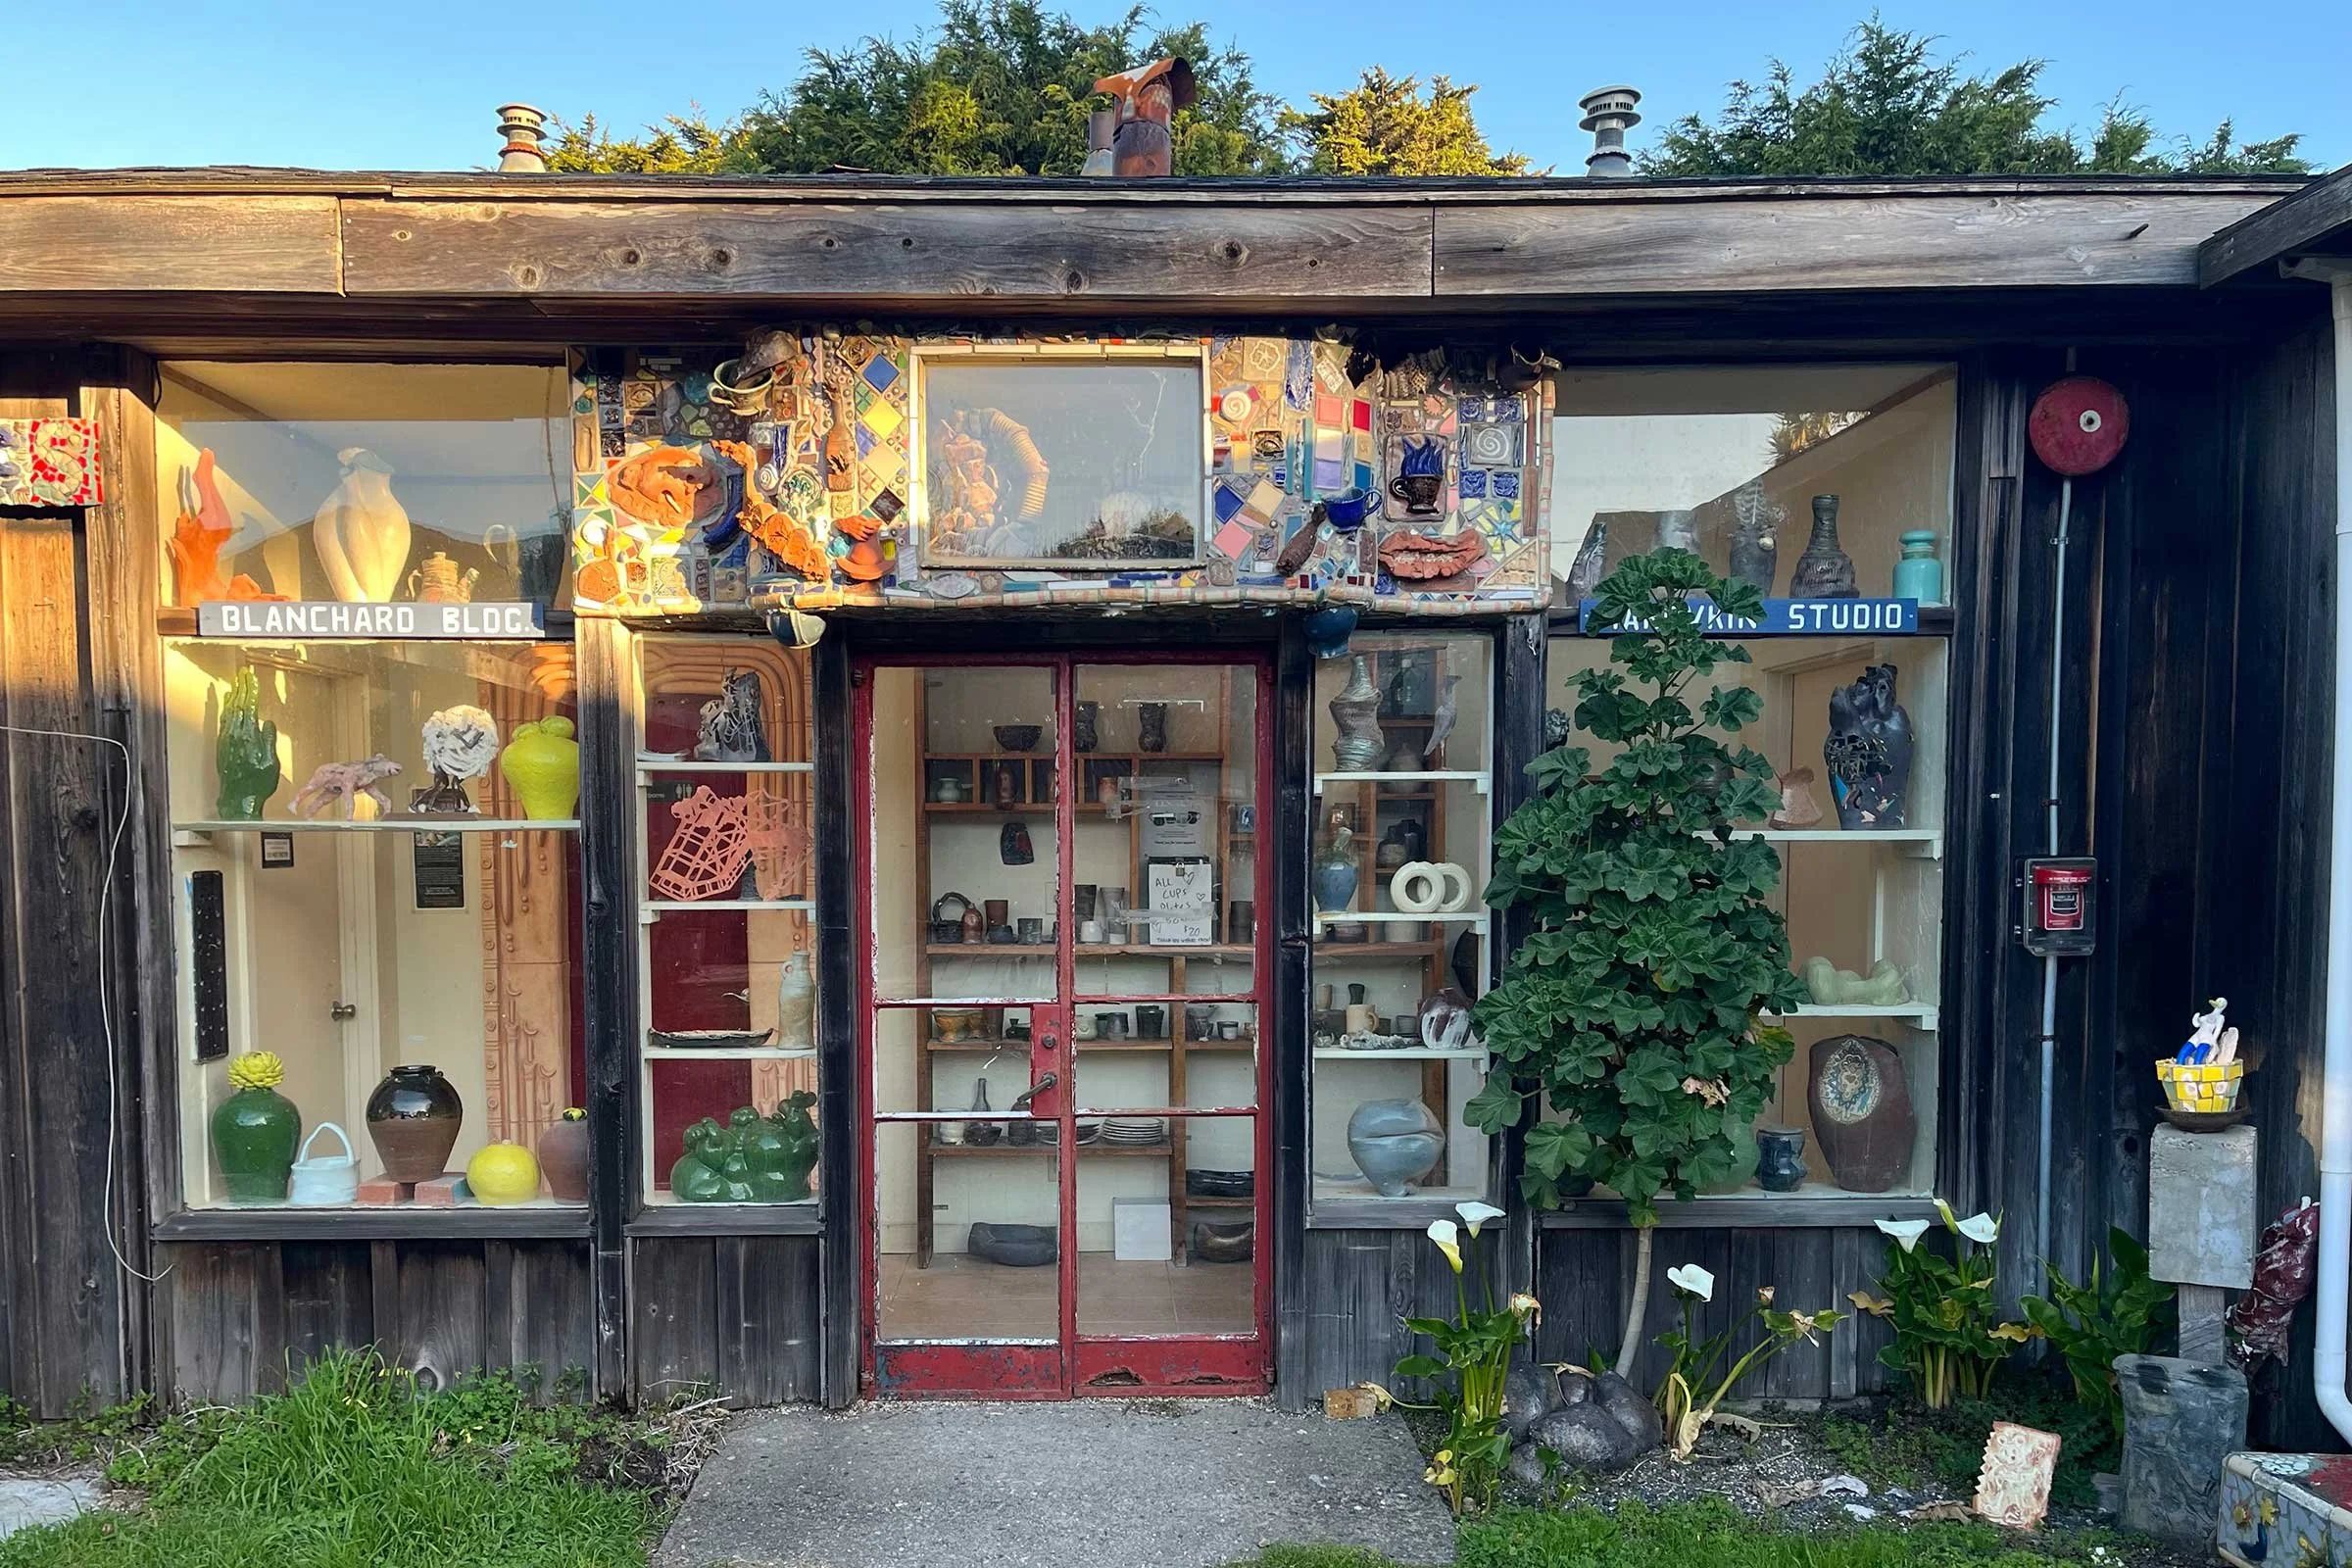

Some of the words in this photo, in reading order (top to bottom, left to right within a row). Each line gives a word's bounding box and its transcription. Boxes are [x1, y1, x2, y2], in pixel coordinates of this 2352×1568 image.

[220, 605, 415, 633] BLANCHARD
[442, 607, 530, 634] BLDG.
[1788, 604, 1902, 629] STUDIO
[1155, 877, 1173, 888] ALL
